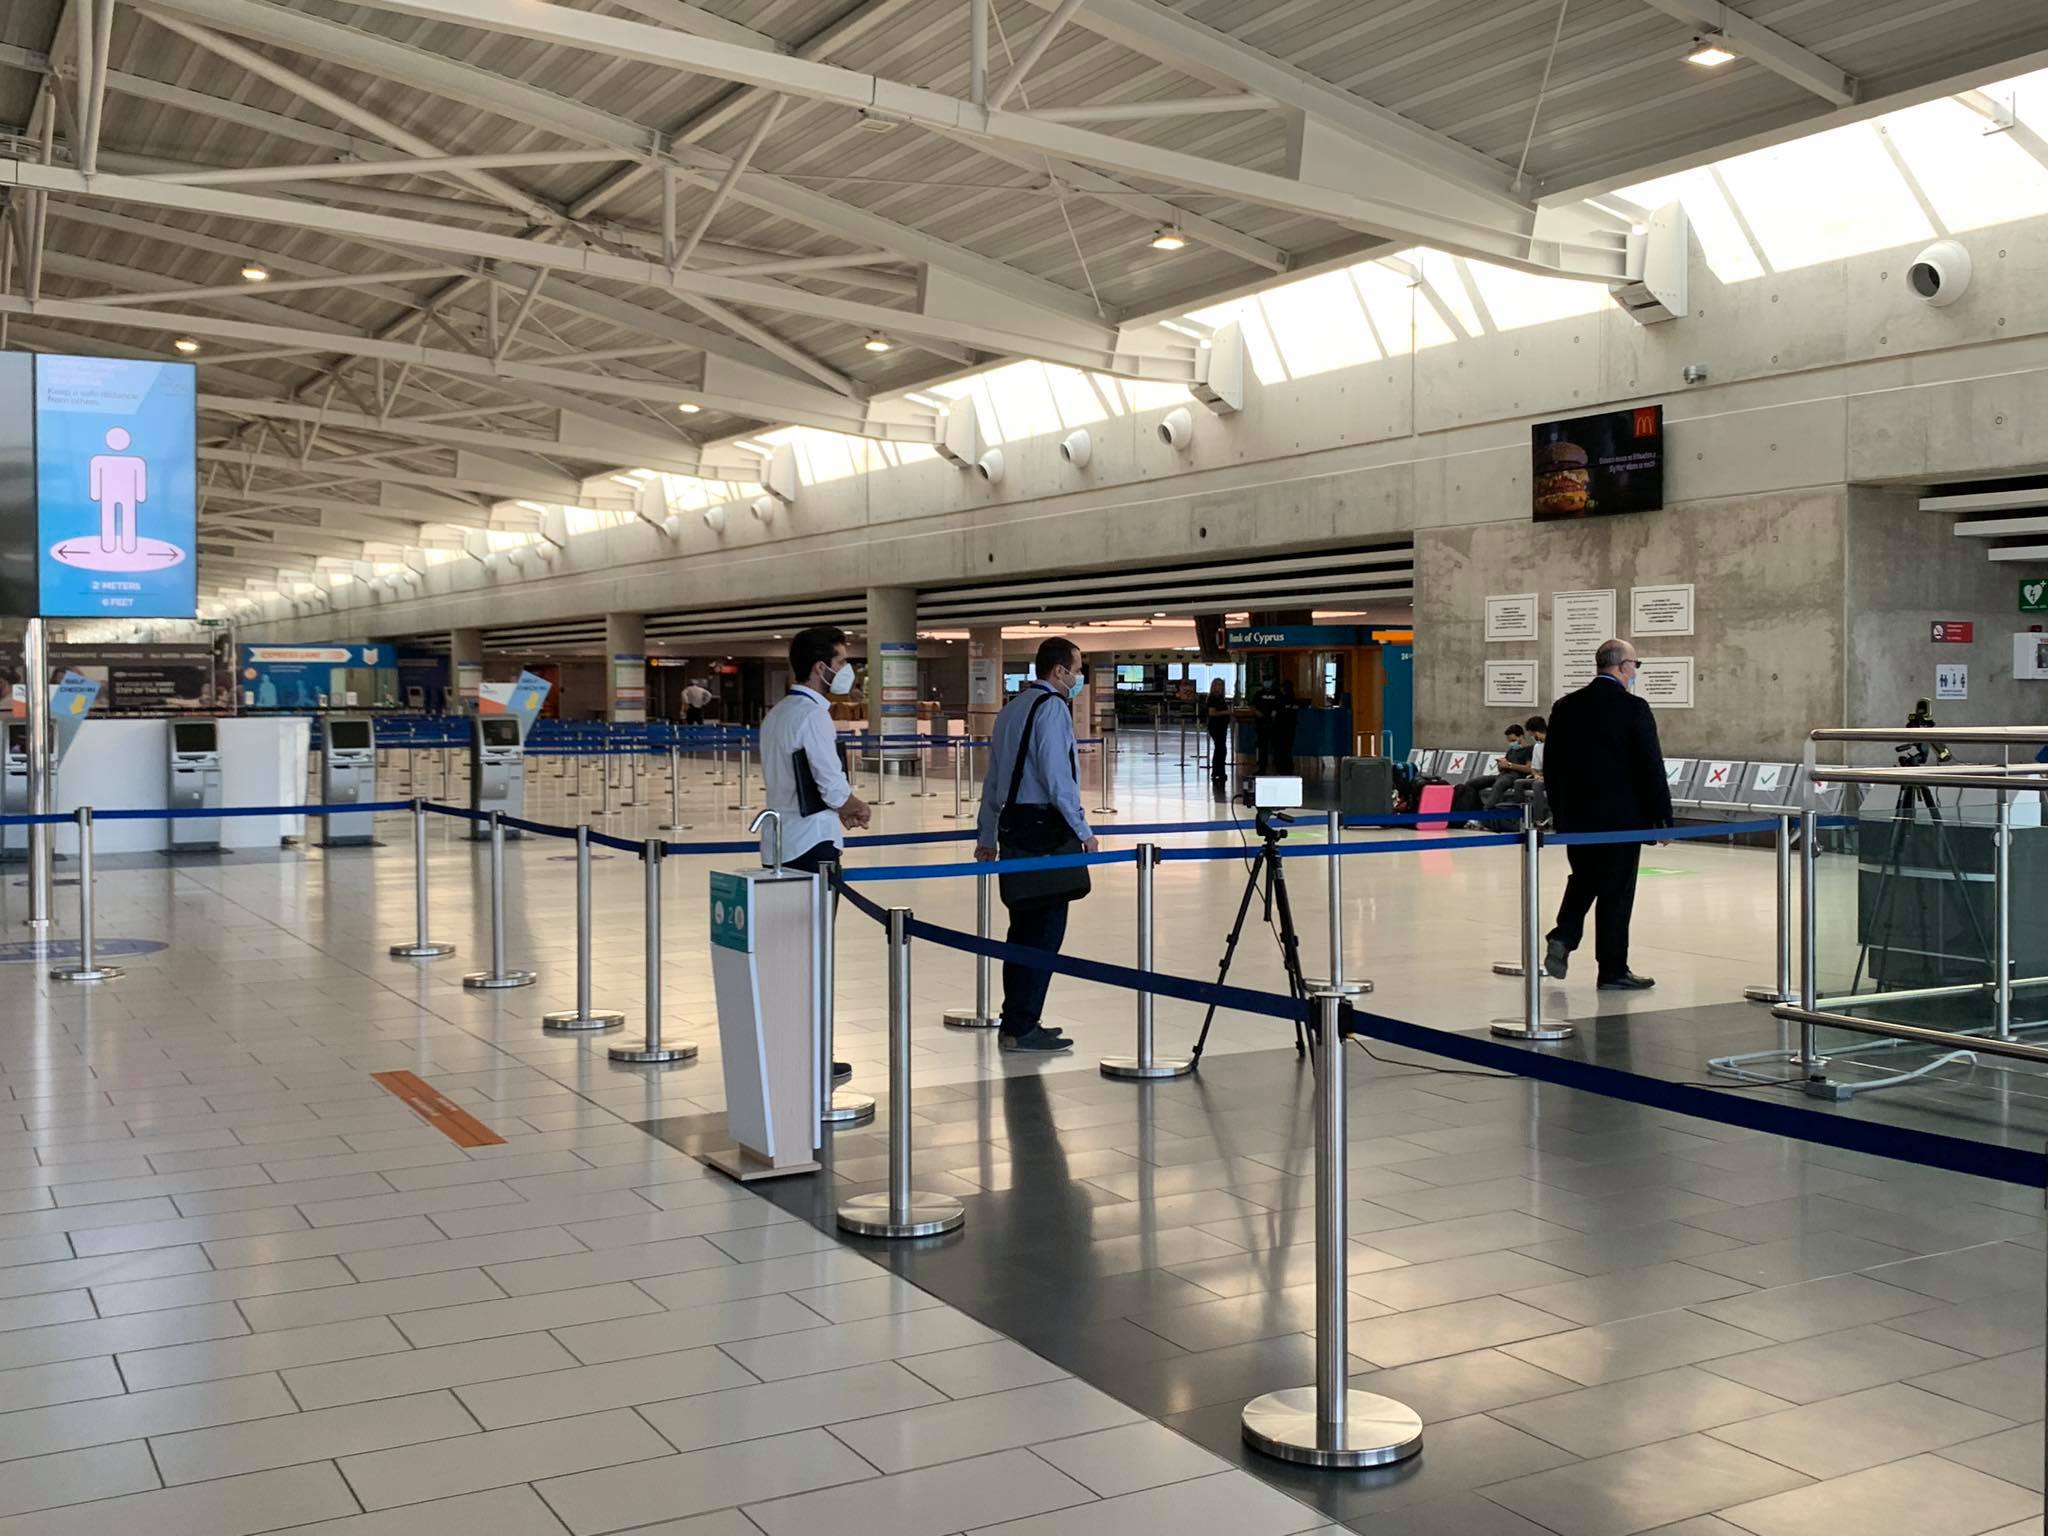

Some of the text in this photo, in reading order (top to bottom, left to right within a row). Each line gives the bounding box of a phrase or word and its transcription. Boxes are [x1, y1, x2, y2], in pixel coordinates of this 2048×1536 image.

[91, 581, 142, 591] 2 METERS
[110, 598, 134, 607] FEET
[1244, 632, 1253, 642] of
[1253, 632, 1285, 645] Cyprus
